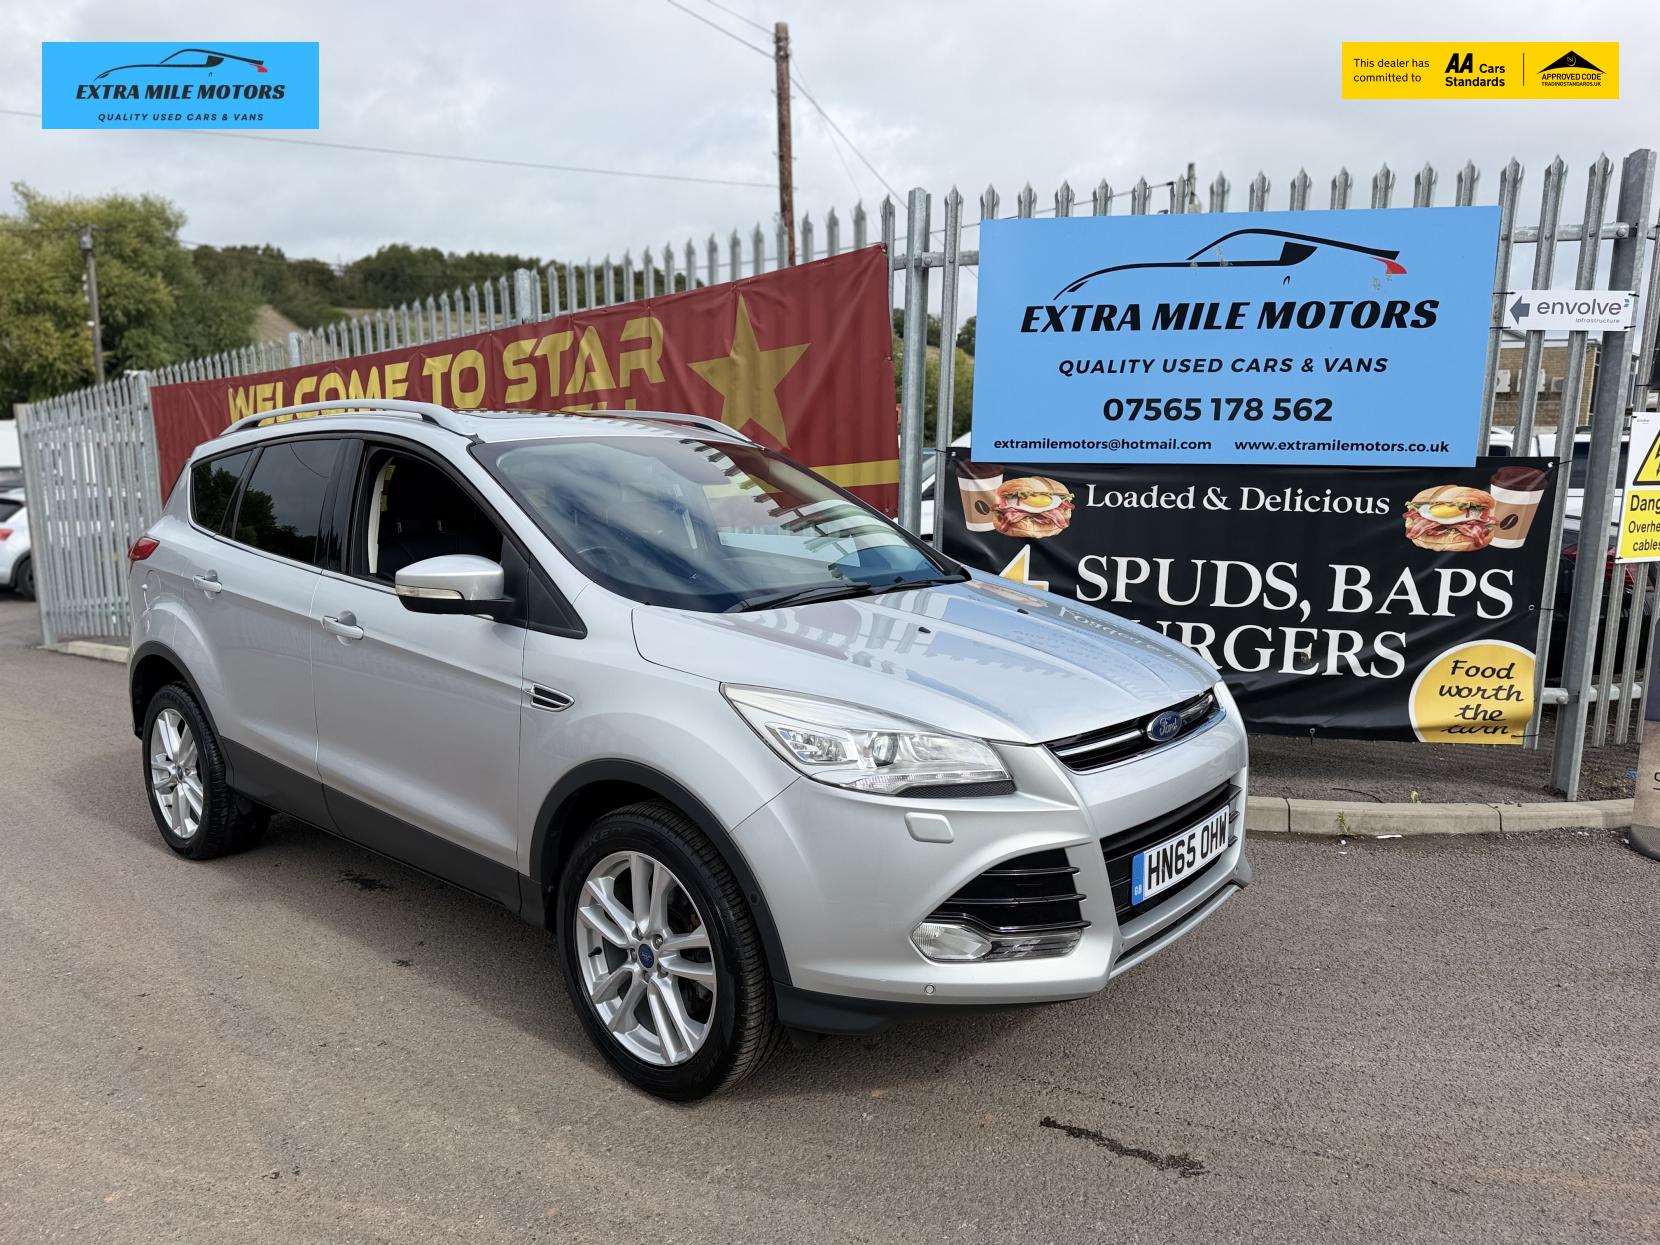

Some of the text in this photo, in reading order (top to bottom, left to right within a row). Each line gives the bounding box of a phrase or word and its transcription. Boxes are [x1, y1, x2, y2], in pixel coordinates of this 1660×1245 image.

[1020, 299, 1440, 333] EXTRA MILE MOTORS
[1536, 298, 1622, 316] envolve
[227, 316, 666, 426] WELCOME TO STAR
[1058, 357, 1389, 377] QUALITY USED CARS & VANS
[1103, 398, 1334, 422] 07565 178 562
[993, 438, 1450, 454] extramilemotors@hotmail.com www.extramilemotors.co.uk
[1086, 483, 1391, 516] Loaded & Delicious
[1075, 555, 1514, 622] SPUDS, BAPS
[1450, 659, 1515, 680] Food
[1438, 684, 1524, 702] worth
[1454, 703, 1507, 721] the
[1159, 715, 1179, 735] Ford
[1147, 811, 1227, 891] HN65 OHW
